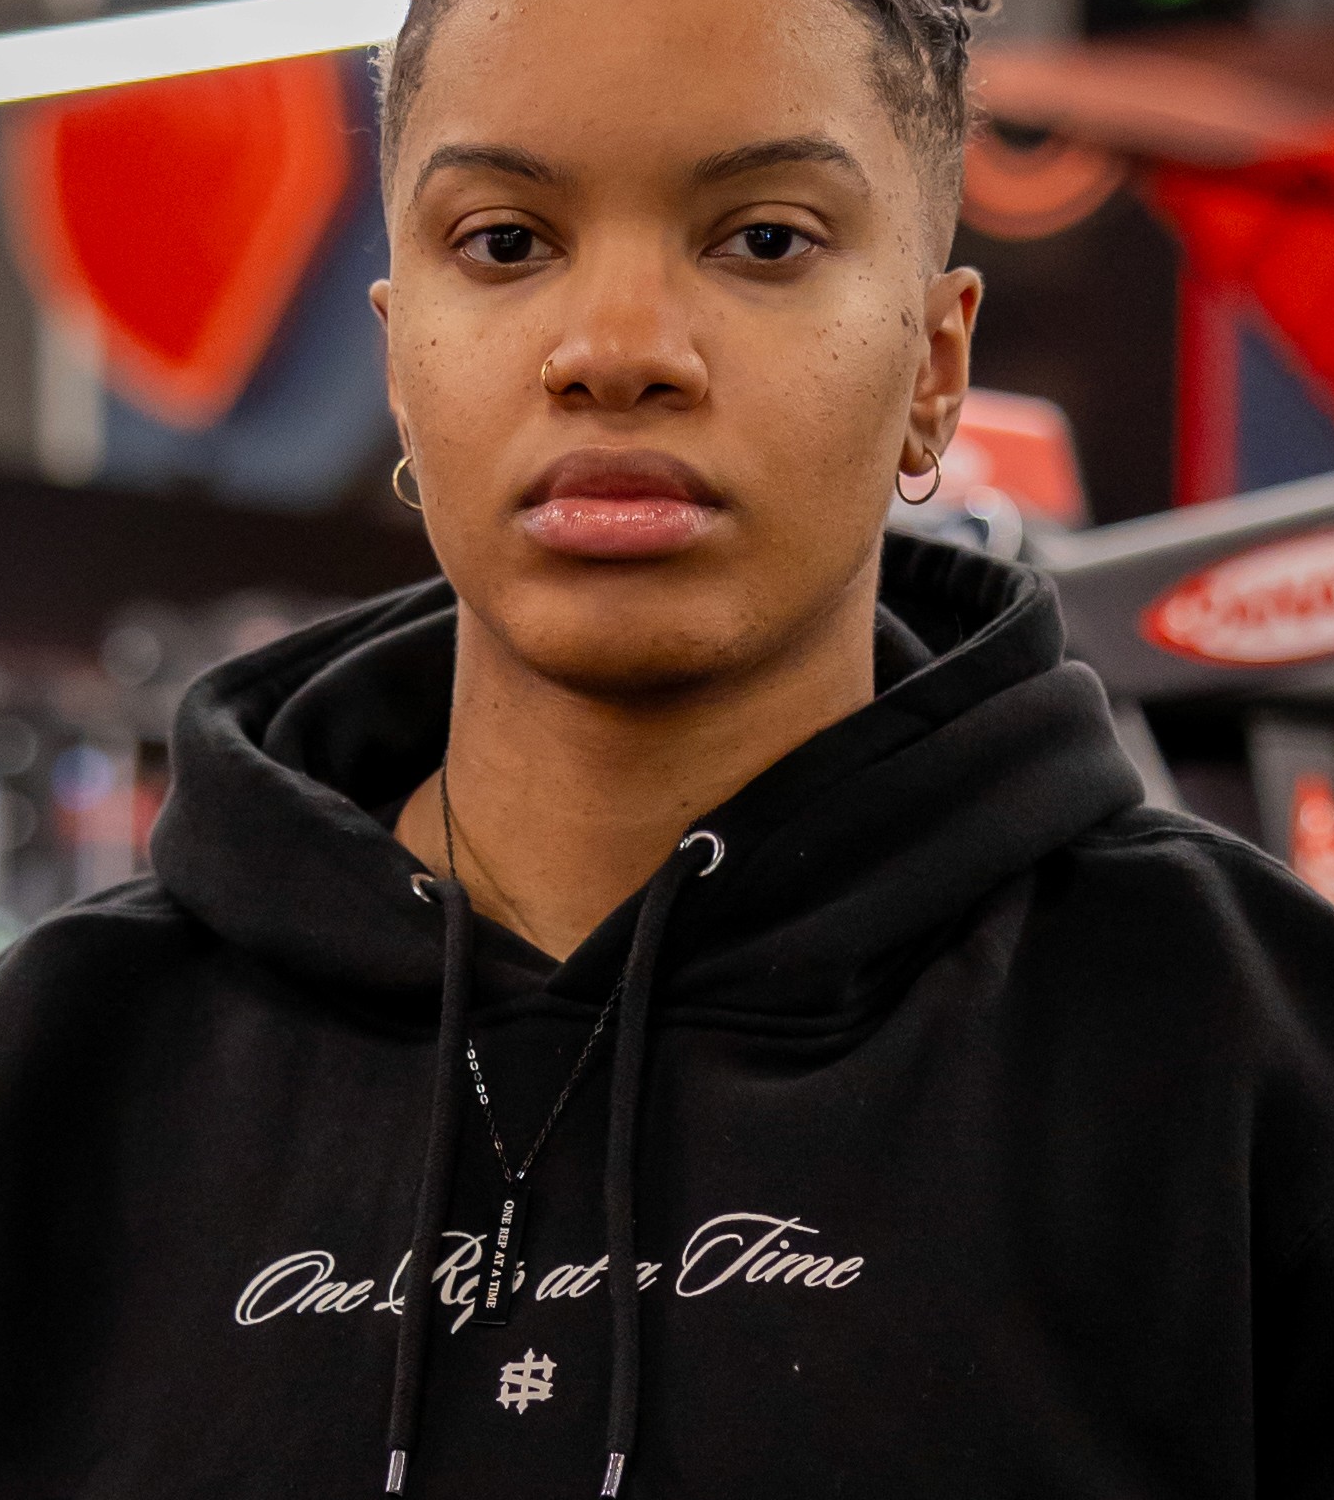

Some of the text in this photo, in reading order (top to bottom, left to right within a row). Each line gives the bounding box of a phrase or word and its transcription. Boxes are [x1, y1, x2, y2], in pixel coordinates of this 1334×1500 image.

[234, 1249, 376, 1326] One
[535, 1254, 610, 1301] at
[675, 1211, 865, 1297] Time
[486, 1200, 515, 1309] ONE REP AT A TIME
